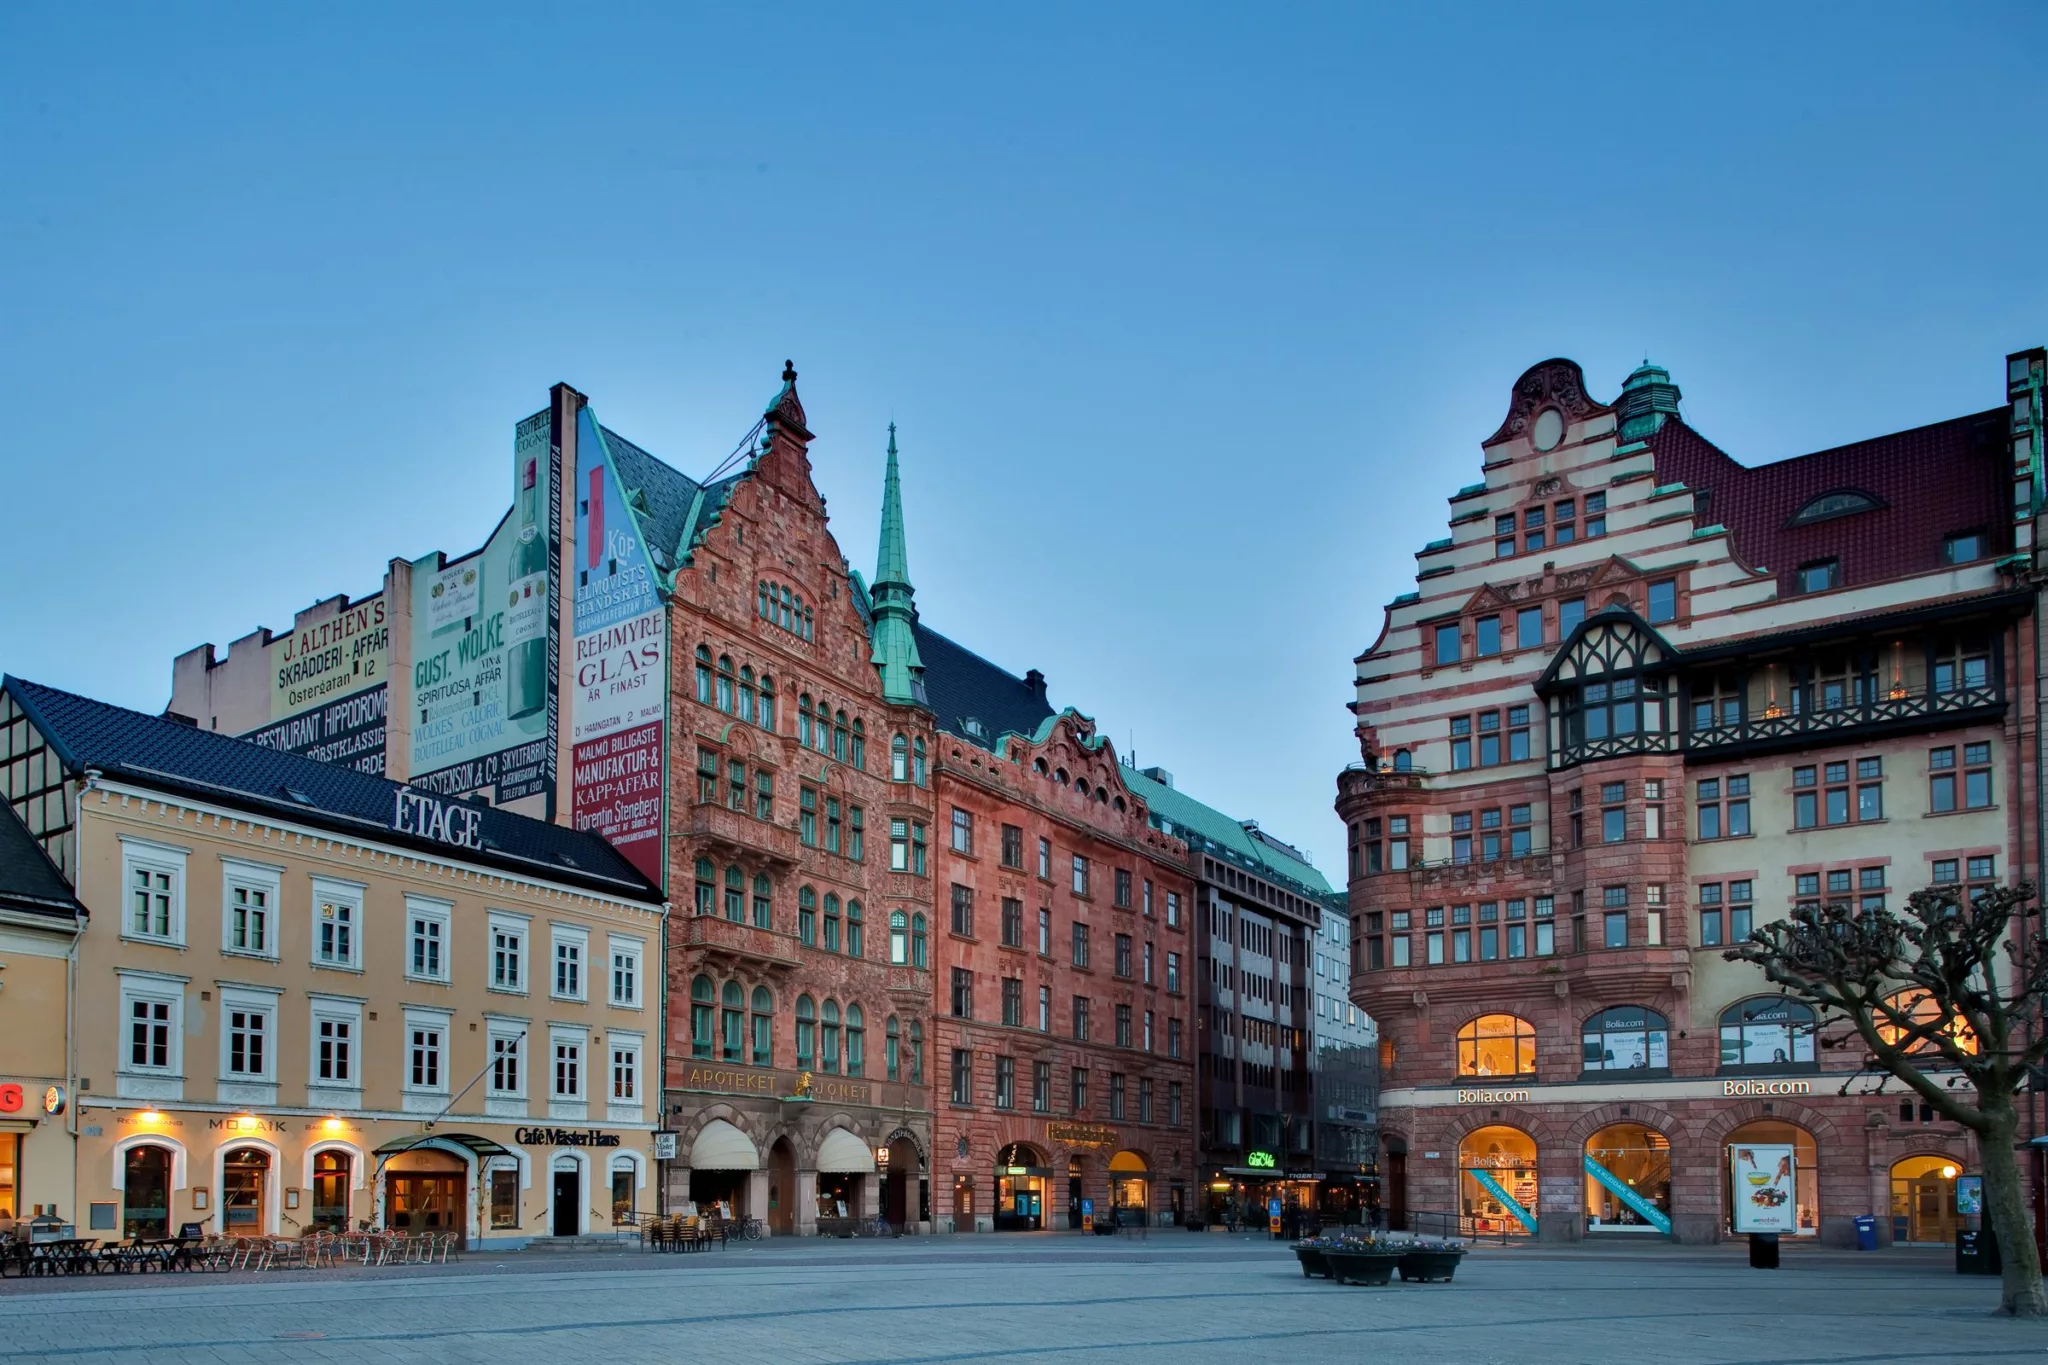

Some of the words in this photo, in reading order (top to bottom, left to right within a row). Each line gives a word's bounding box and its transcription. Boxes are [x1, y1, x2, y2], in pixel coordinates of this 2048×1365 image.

[284, 639, 296, 662] J.
[416, 649, 452, 689] GUST.
[458, 612, 504, 668] WOLKE
[577, 613, 662, 661] REIJMYRE
[279, 646, 342, 689] SKRÄDDERI
[352, 627, 388, 660] AFFÄR
[549, 625, 558, 686] GENOM
[578, 641, 659, 687] GLAS
[289, 672, 350, 706] Östergatan
[364, 659, 375, 678] 12
[417, 678, 471, 707] SPIRITUOSA
[588, 687, 601, 702] ÄR
[610, 673, 648, 695] FINAST
[547, 692, 557, 783] ANNONSERA
[584, 716, 620, 734] HAMNGATAN
[627, 711, 633, 722] 2
[502, 740, 547, 771] SKYLTFABRIK
[578, 739, 608, 762] MALMÖ
[612, 727, 657, 753] BILLIGASTE
[539, 761, 545, 776] 4
[502, 785, 526, 800] TELEFON
[576, 771, 660, 806] KAPP-AFFÄR
[393, 786, 482, 850] ÉTAGE
[576, 806, 612, 831] Florentin
[615, 796, 658, 822] Steneberg
[1606, 1020, 1644, 1028] Bolia.com
[1745, 1011, 1788, 1021] lia.com
[690, 1069, 776, 1089] APOTEKET
[796, 1080, 867, 1099] JONET
[1458, 1089, 1529, 1103] Bolia.com
[1723, 1080, 1810, 1096] Bolia.com
[515, 1127, 545, 1145] Café
[545, 1128, 588, 1146] Mäster
[588, 1130, 620, 1147] Hans
[1482, 1177, 1493, 1189] FRI
[1493, 1186, 1525, 1219] LEVERANS
